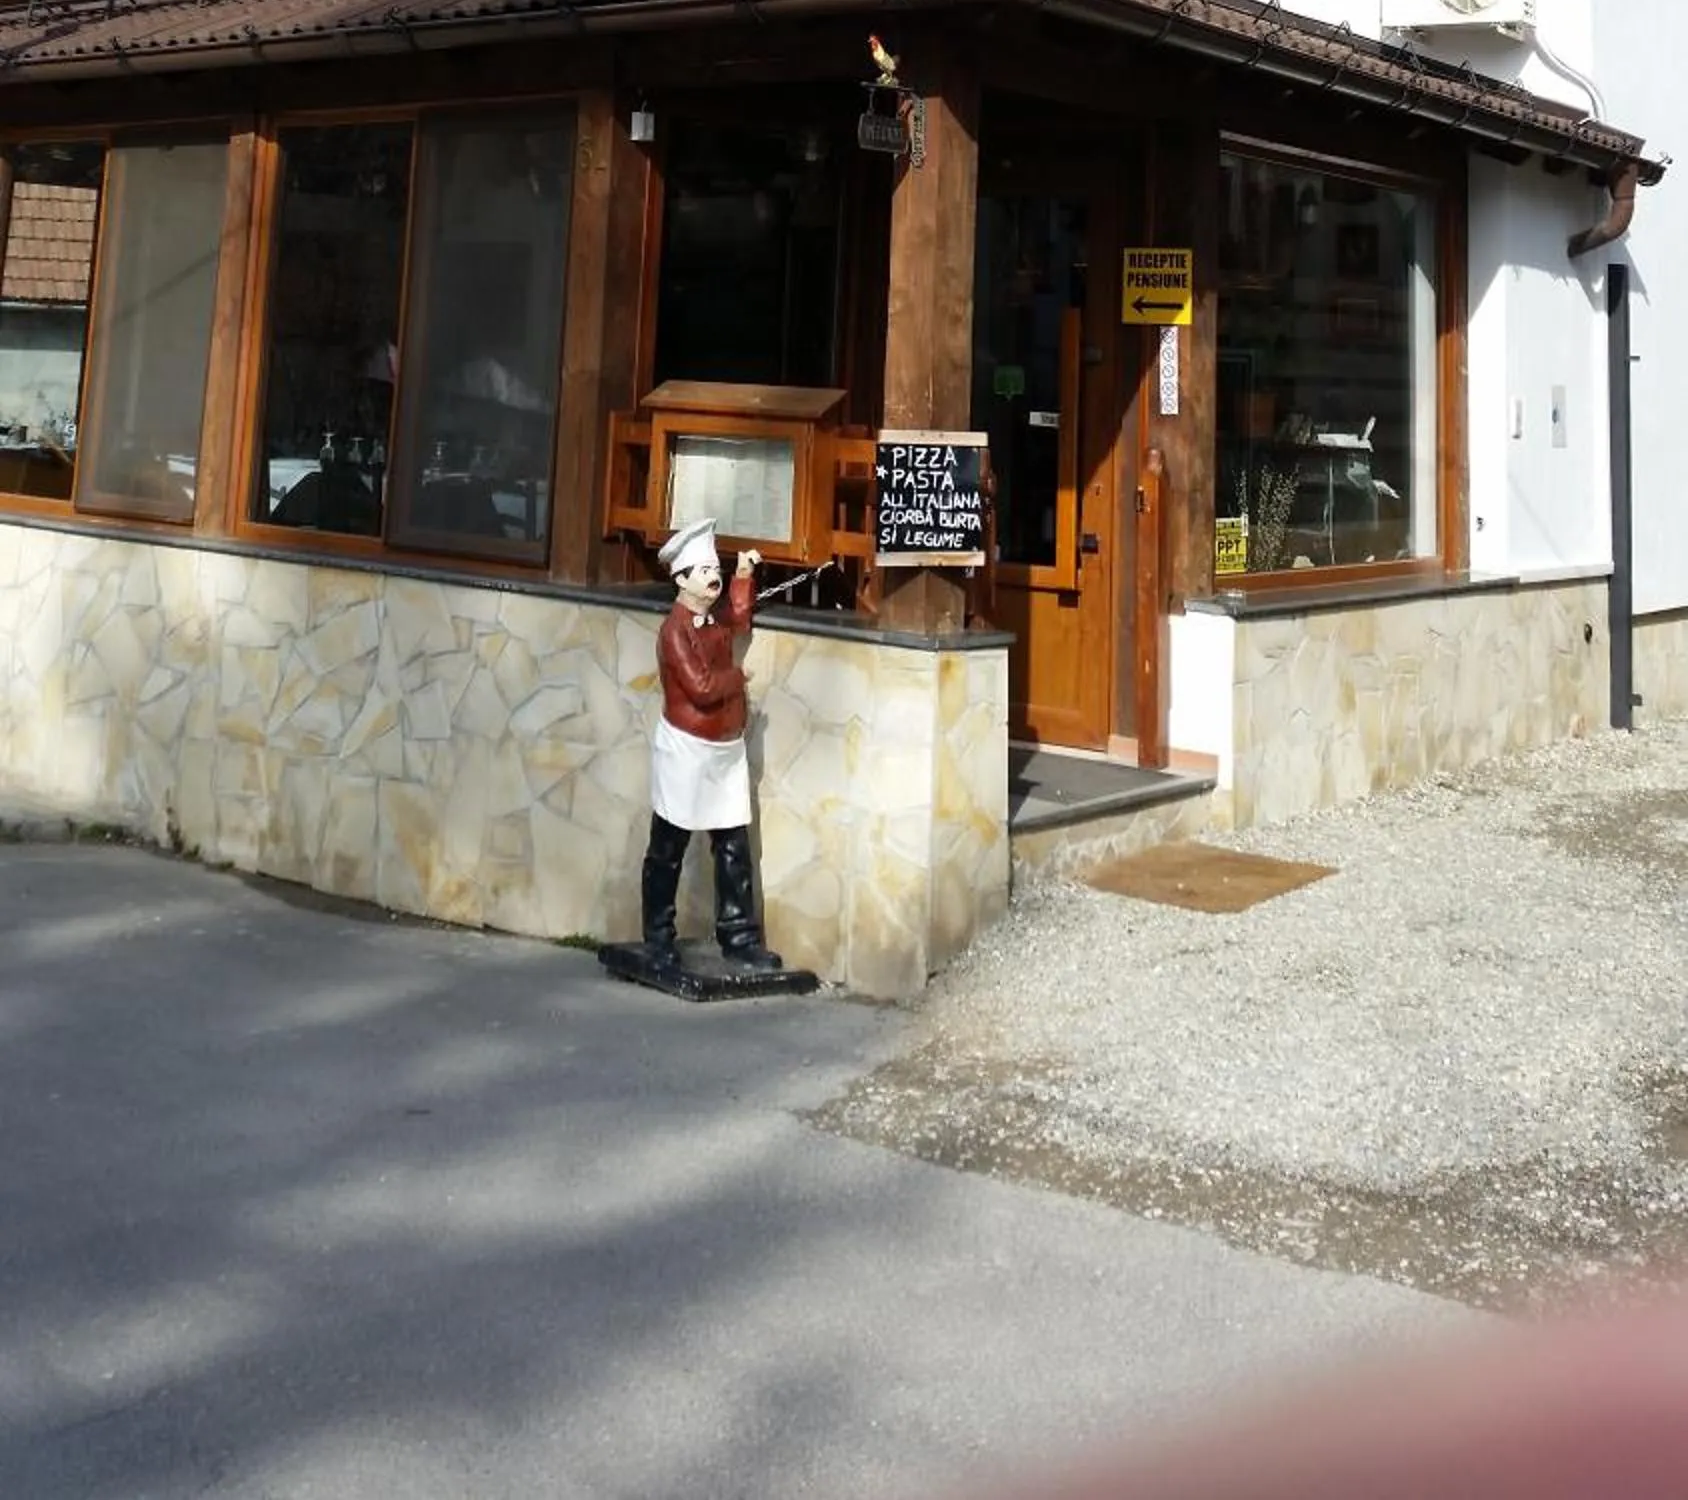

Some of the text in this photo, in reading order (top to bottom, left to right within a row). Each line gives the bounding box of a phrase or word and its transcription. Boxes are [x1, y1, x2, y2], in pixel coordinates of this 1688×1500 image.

[1128, 253, 1188, 268] RECEPTIE
[1127, 273, 1188, 288] PENSIUNE
[892, 446, 958, 468] PIZZA
[892, 469, 955, 490] PASTA
[903, 529, 965, 548] LEGUME
